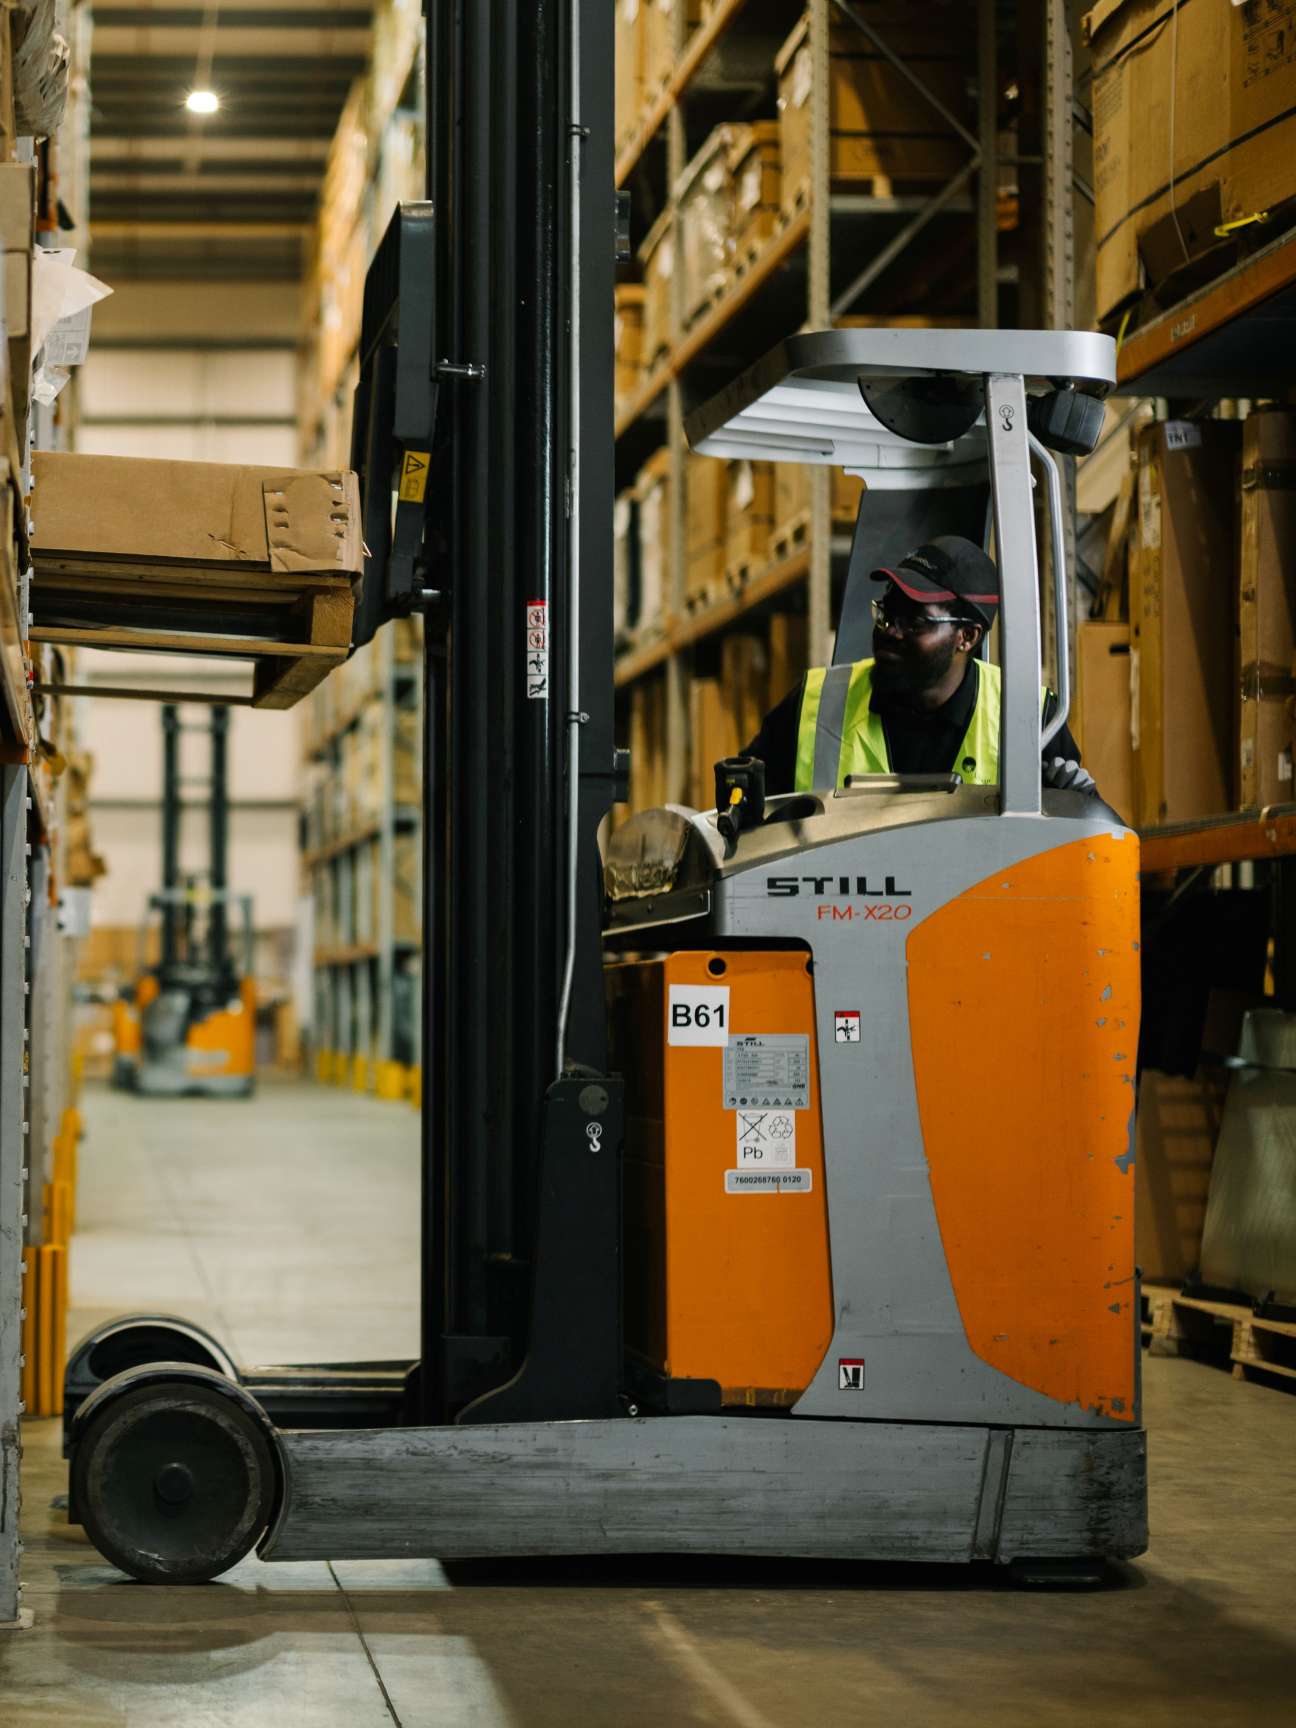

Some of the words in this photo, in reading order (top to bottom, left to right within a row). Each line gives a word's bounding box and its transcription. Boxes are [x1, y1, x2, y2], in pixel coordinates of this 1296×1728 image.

[767, 876, 912, 896] STILL
[817, 904, 913, 920] FM-X20
[672, 1004, 724, 1028] B61
[743, 1146, 763, 1160] Pb
